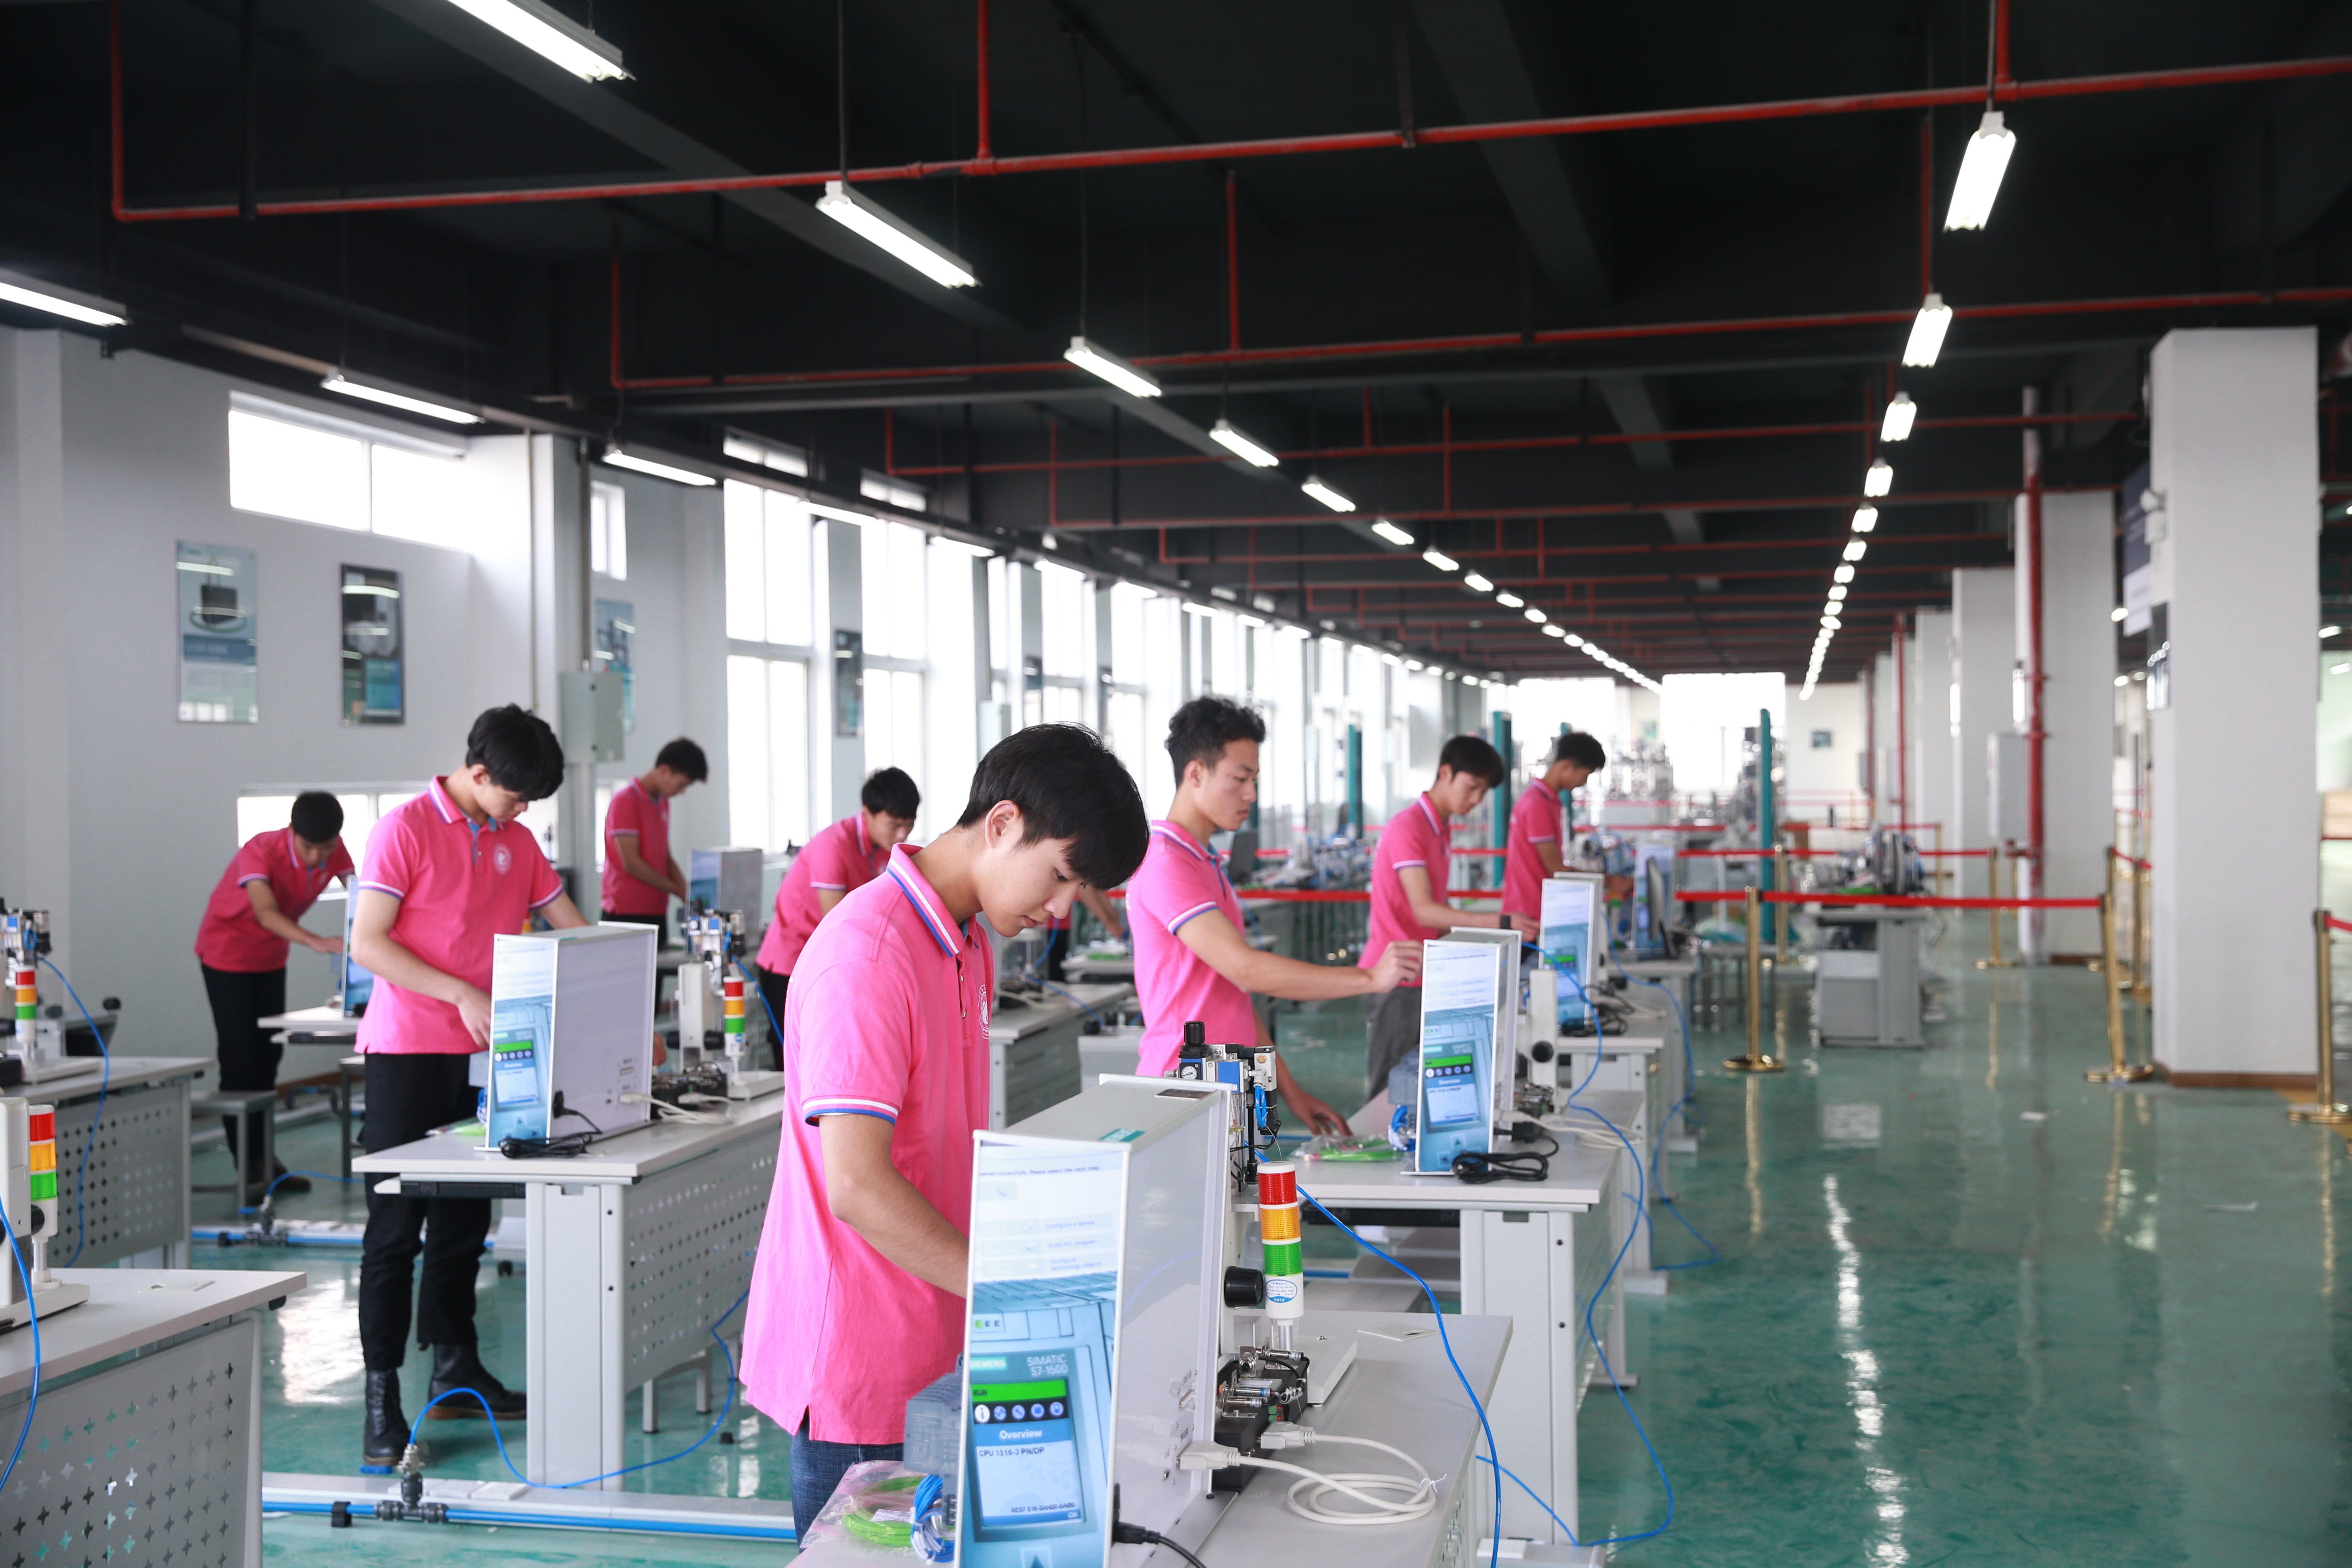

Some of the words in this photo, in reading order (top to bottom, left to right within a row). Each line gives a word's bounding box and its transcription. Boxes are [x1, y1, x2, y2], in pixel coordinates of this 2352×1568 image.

[970, 1358, 1006, 1368] SIEMENS
[1027, 1354, 1066, 1366] SIMATIC
[1031, 1364, 1068, 1376] S7-1500
[1000, 1429, 1042, 1439] Overview
[1021, 1447, 1044, 1455] PN/DP
